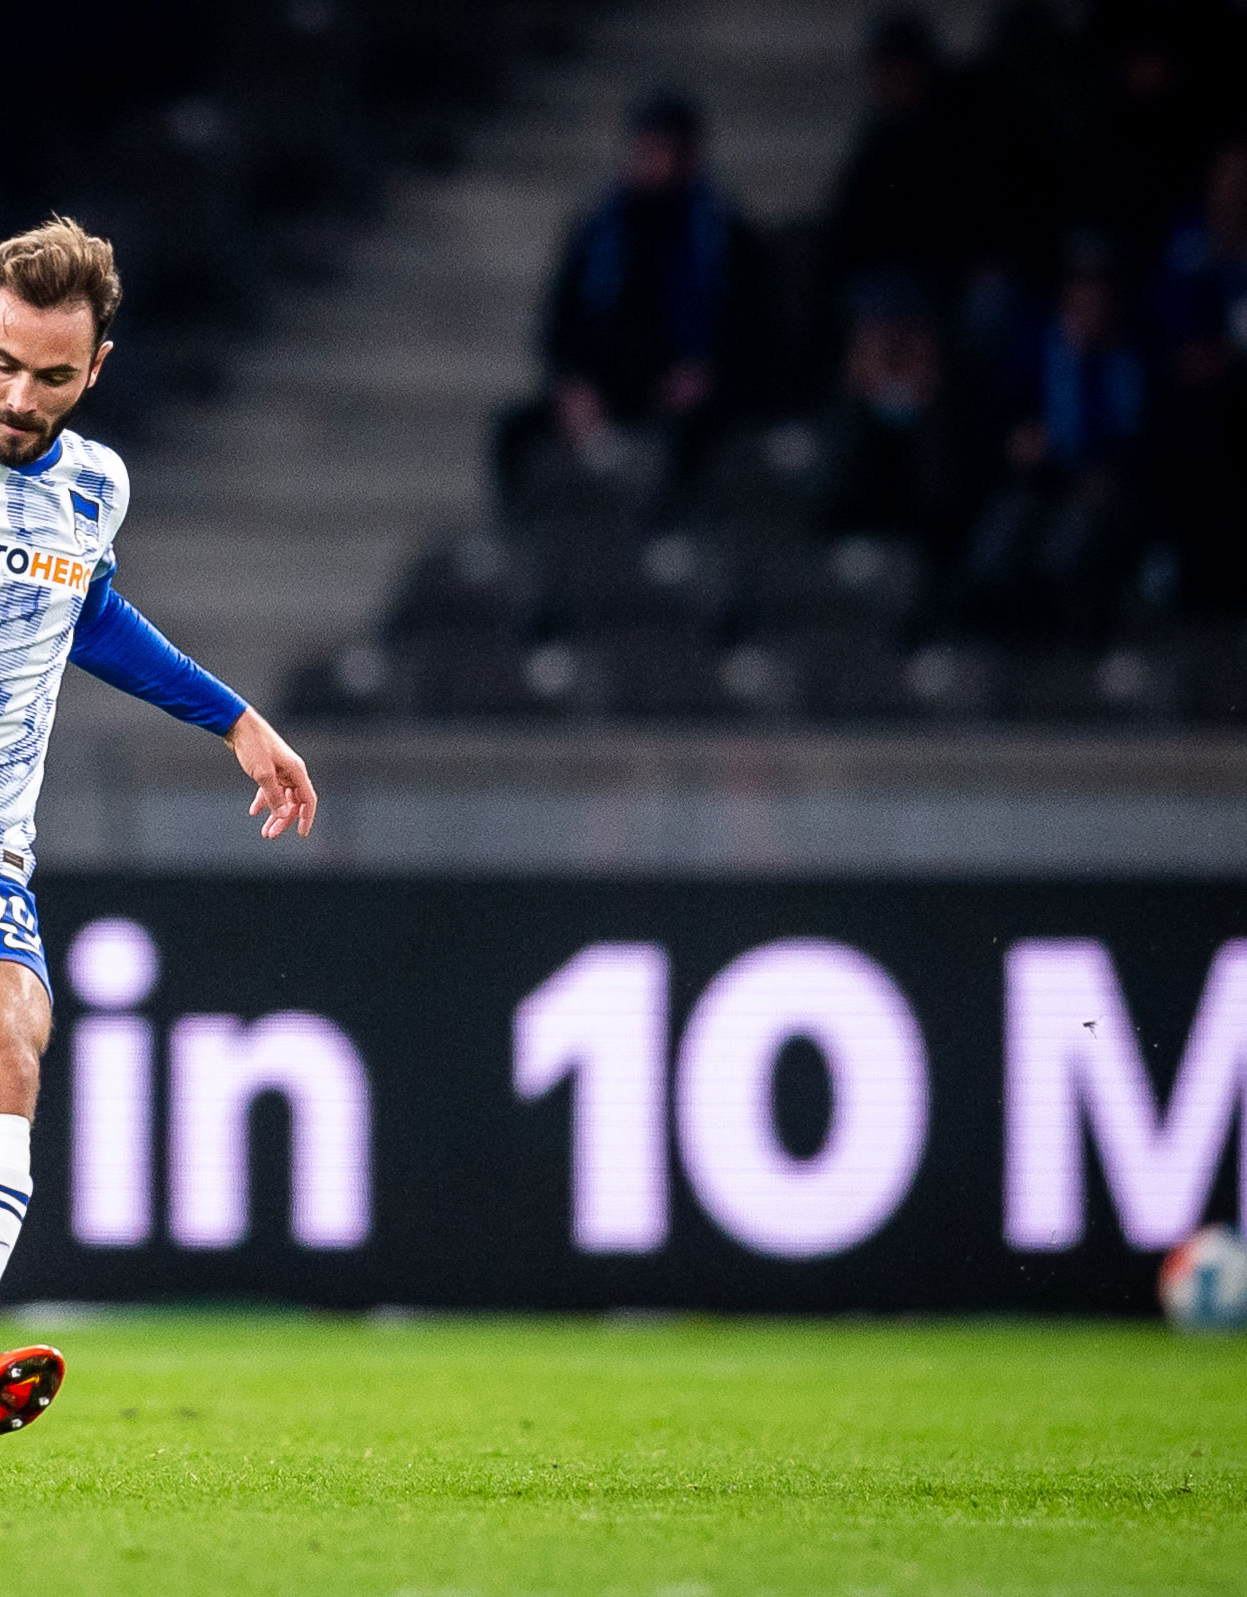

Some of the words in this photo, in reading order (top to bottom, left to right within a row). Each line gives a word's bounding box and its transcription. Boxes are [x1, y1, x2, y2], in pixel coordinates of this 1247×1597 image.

[68, 918, 371, 1248] in
[513, 938, 928, 1259] 10
[1004, 938, 1247, 1250] M
